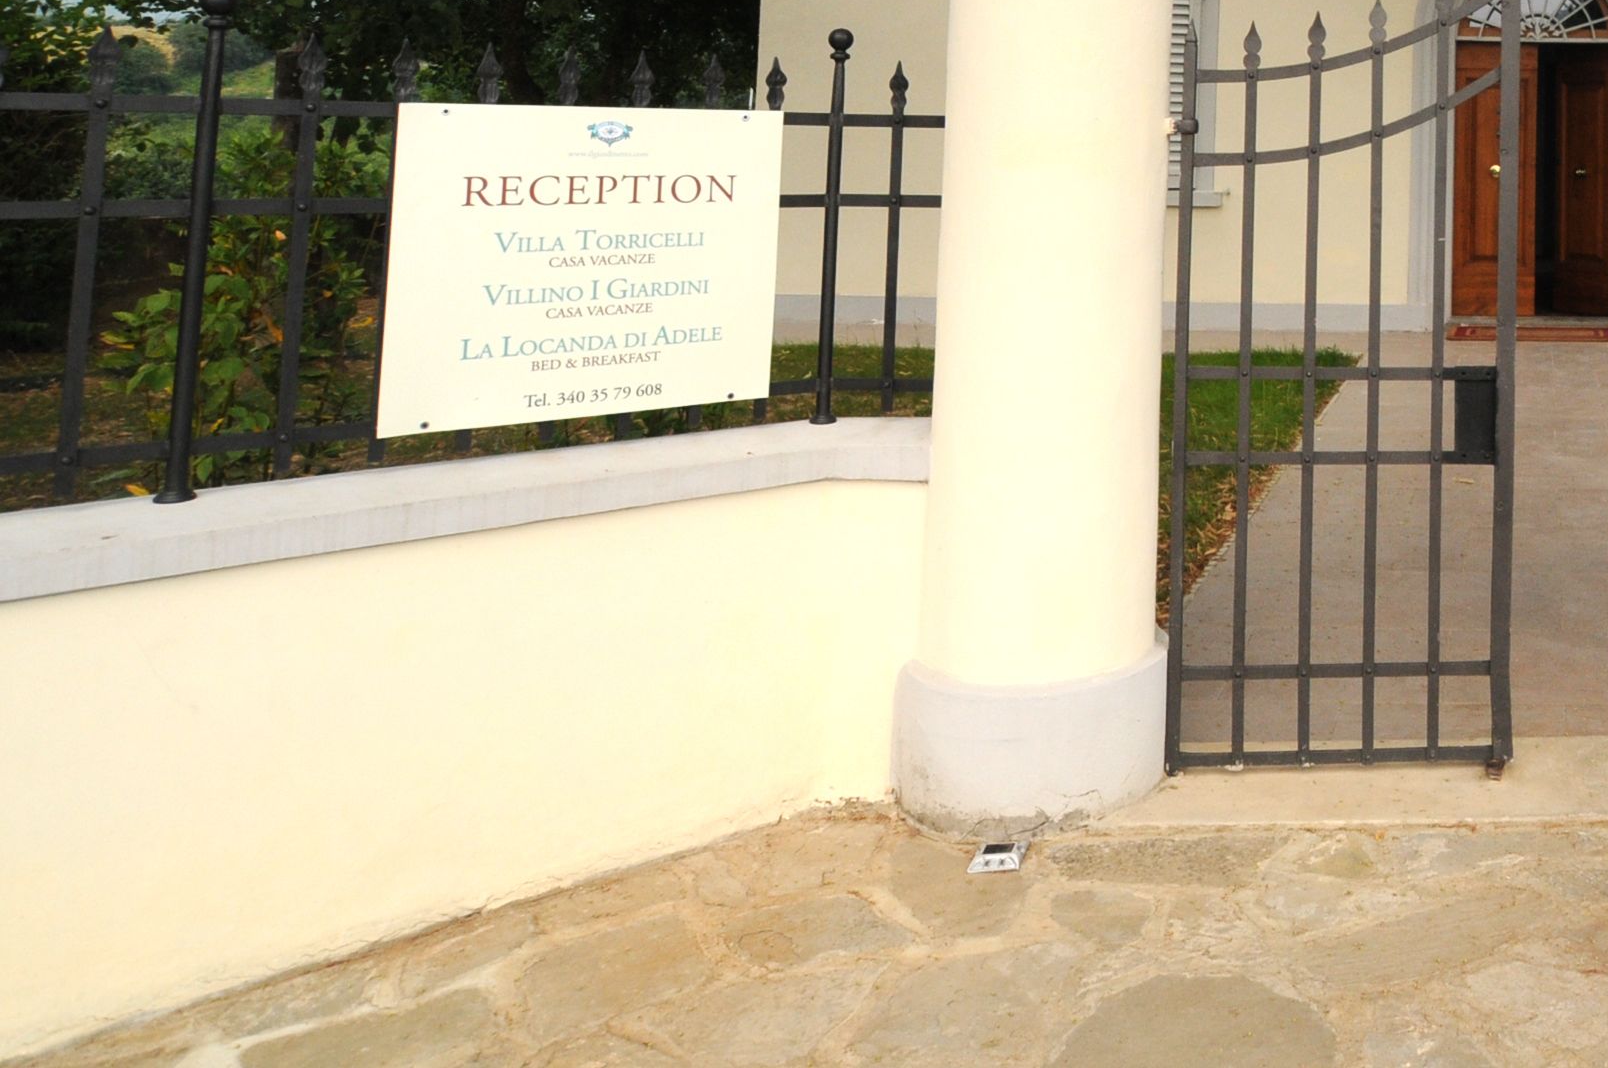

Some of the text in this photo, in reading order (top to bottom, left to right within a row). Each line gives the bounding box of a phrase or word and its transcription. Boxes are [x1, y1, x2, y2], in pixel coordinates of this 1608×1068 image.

[462, 175, 736, 206] RECEPTION
[549, 254, 655, 267] CASA VACANZE
[590, 280, 599, 300] I
[546, 303, 653, 319] CASA VACANZE
[531, 350, 661, 371] BED & BREAKFAST
[524, 384, 662, 407] Tel. 340 35 79 608
